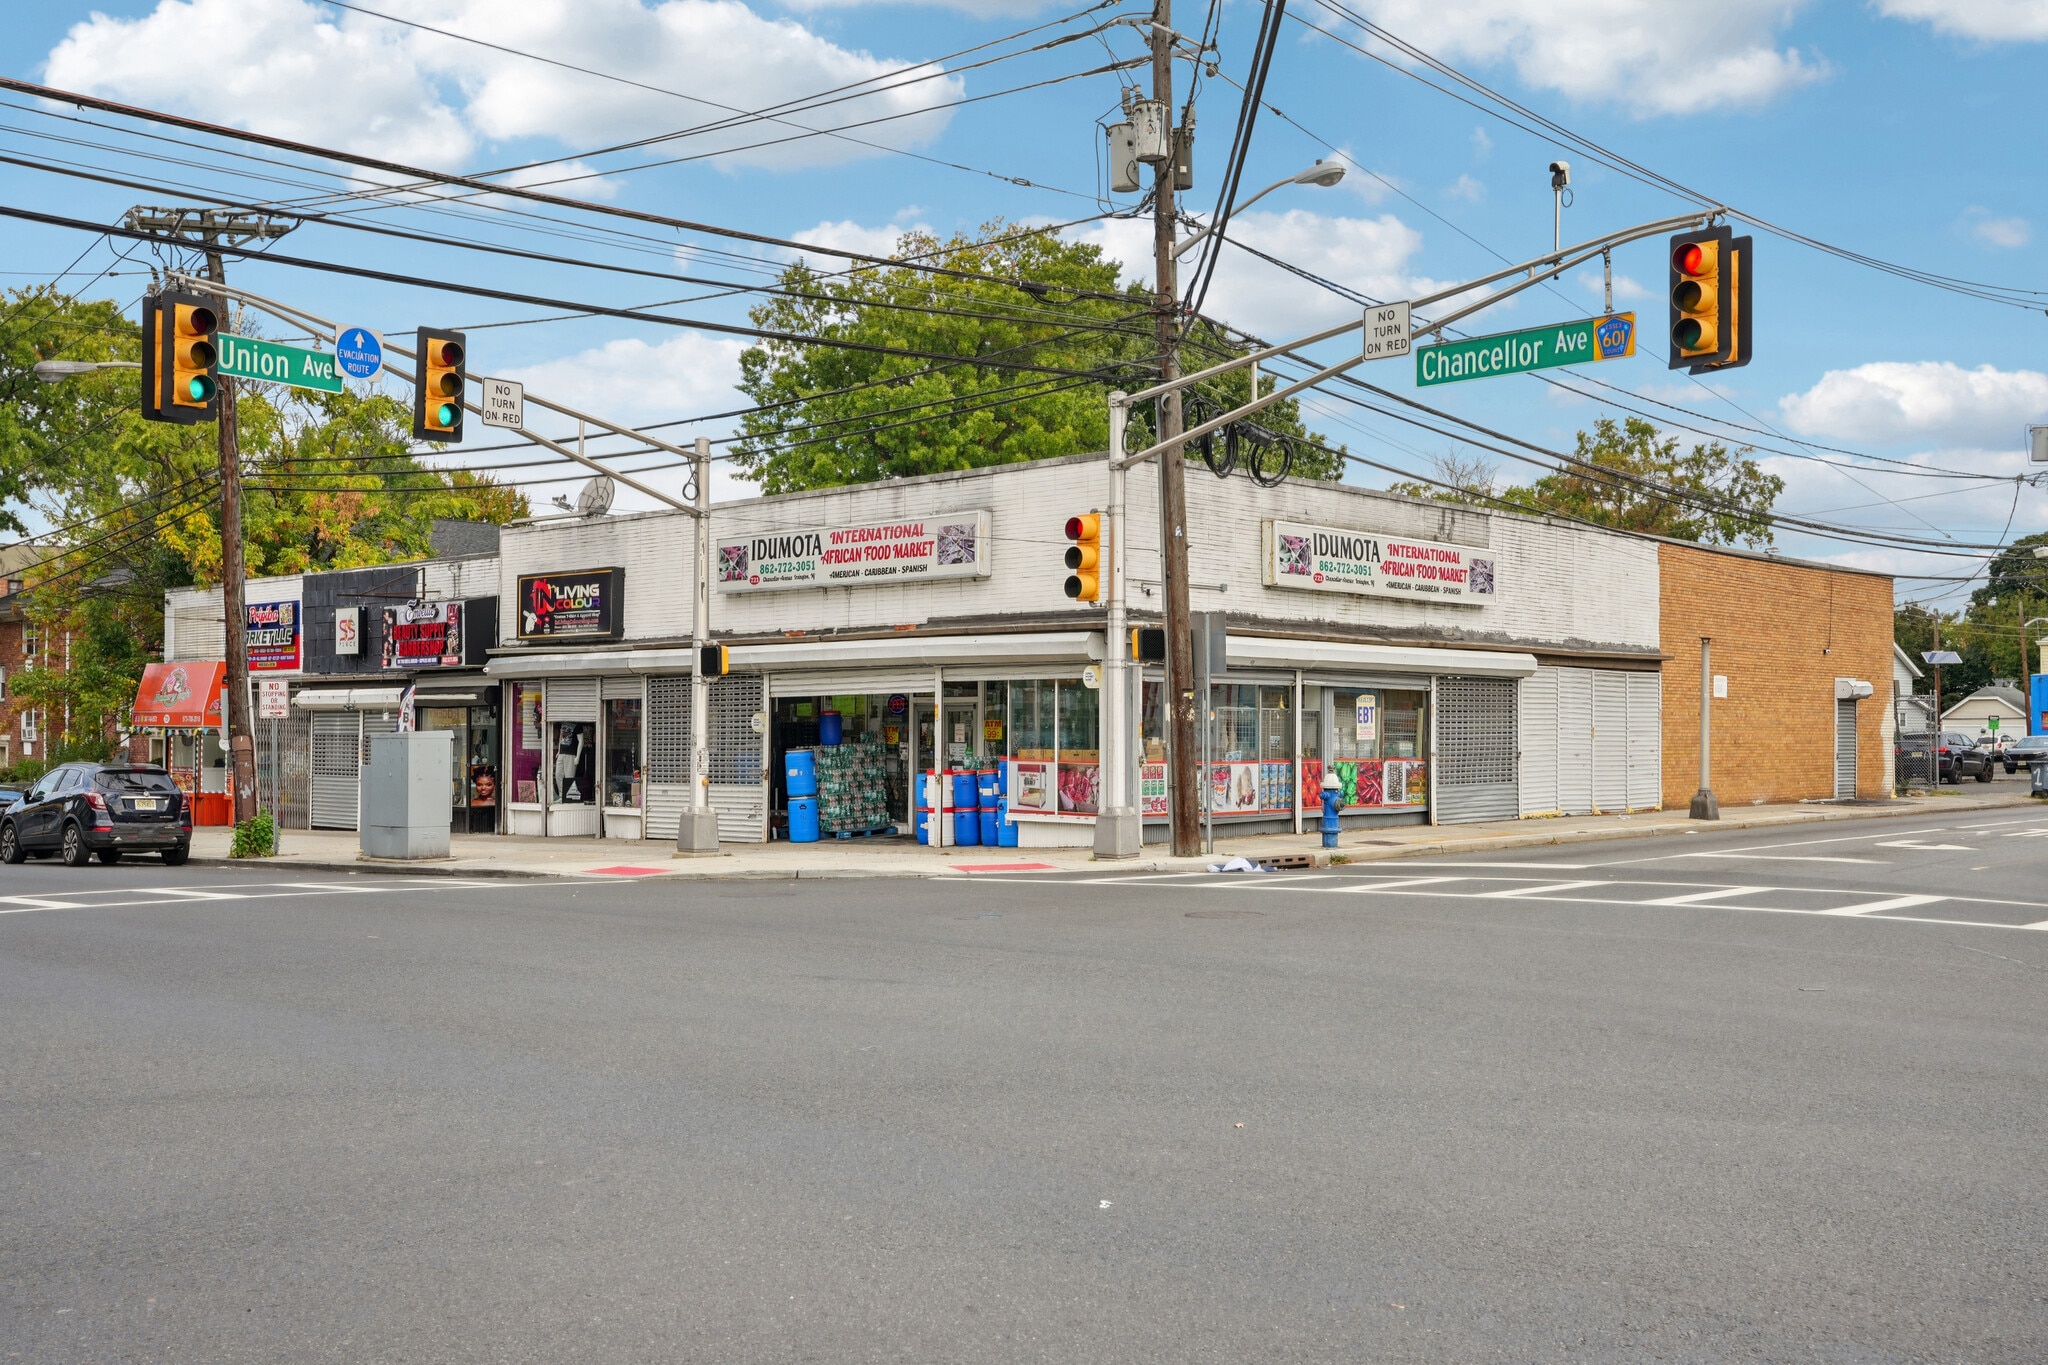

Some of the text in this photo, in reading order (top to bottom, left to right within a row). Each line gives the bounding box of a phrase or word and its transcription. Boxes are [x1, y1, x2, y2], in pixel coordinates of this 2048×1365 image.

[1378, 310, 1395, 322] NO
[1374, 324, 1401, 338] TURN
[1605, 322, 1622, 330] ESSEX
[1367, 338, 1408, 354] ON RED
[1603, 330, 1625, 347] 601
[218, 338, 332, 379] Union Ave
[339, 349, 379, 363] EVACUATION
[1422, 330, 1588, 381] Chancellor Ave
[1604, 346, 1624, 355] COUNTY
[347, 362, 370, 375] ROUTE
[495, 385, 511, 396] NO
[491, 397, 515, 410] TURN
[485, 410, 521, 424] ON RED
[829, 523, 925, 545] INTERNATIONAL
[751, 533, 823, 562] IDUMOTA
[820, 540, 935, 565] AFRICAN FOOD MARKET
[1313, 532, 1381, 563] IDUMOTA
[1387, 543, 1461, 565] INTERNATIONAL
[760, 560, 816, 575] 862-772-3051
[829, 563, 928, 579] AMERICAN CARIBBEAN SPANISH
[1319, 560, 1372, 577] 862-772-3051
[1380, 560, 1468, 583] AFRICAN FOOD MARKET
[555, 583, 600, 600] LIVING
[1385, 581, 1462, 595] AMERICAN CARIBBEAN SPANISH
[556, 597, 601, 610] COLOUR
[273, 628, 293, 645] LLC
[393, 622, 446, 641] BEAUTY SUPPLY
[399, 640, 445, 657] BARBERSHOP
[1357, 706, 1375, 724] EBT
[984, 720, 1002, 728] ATM
